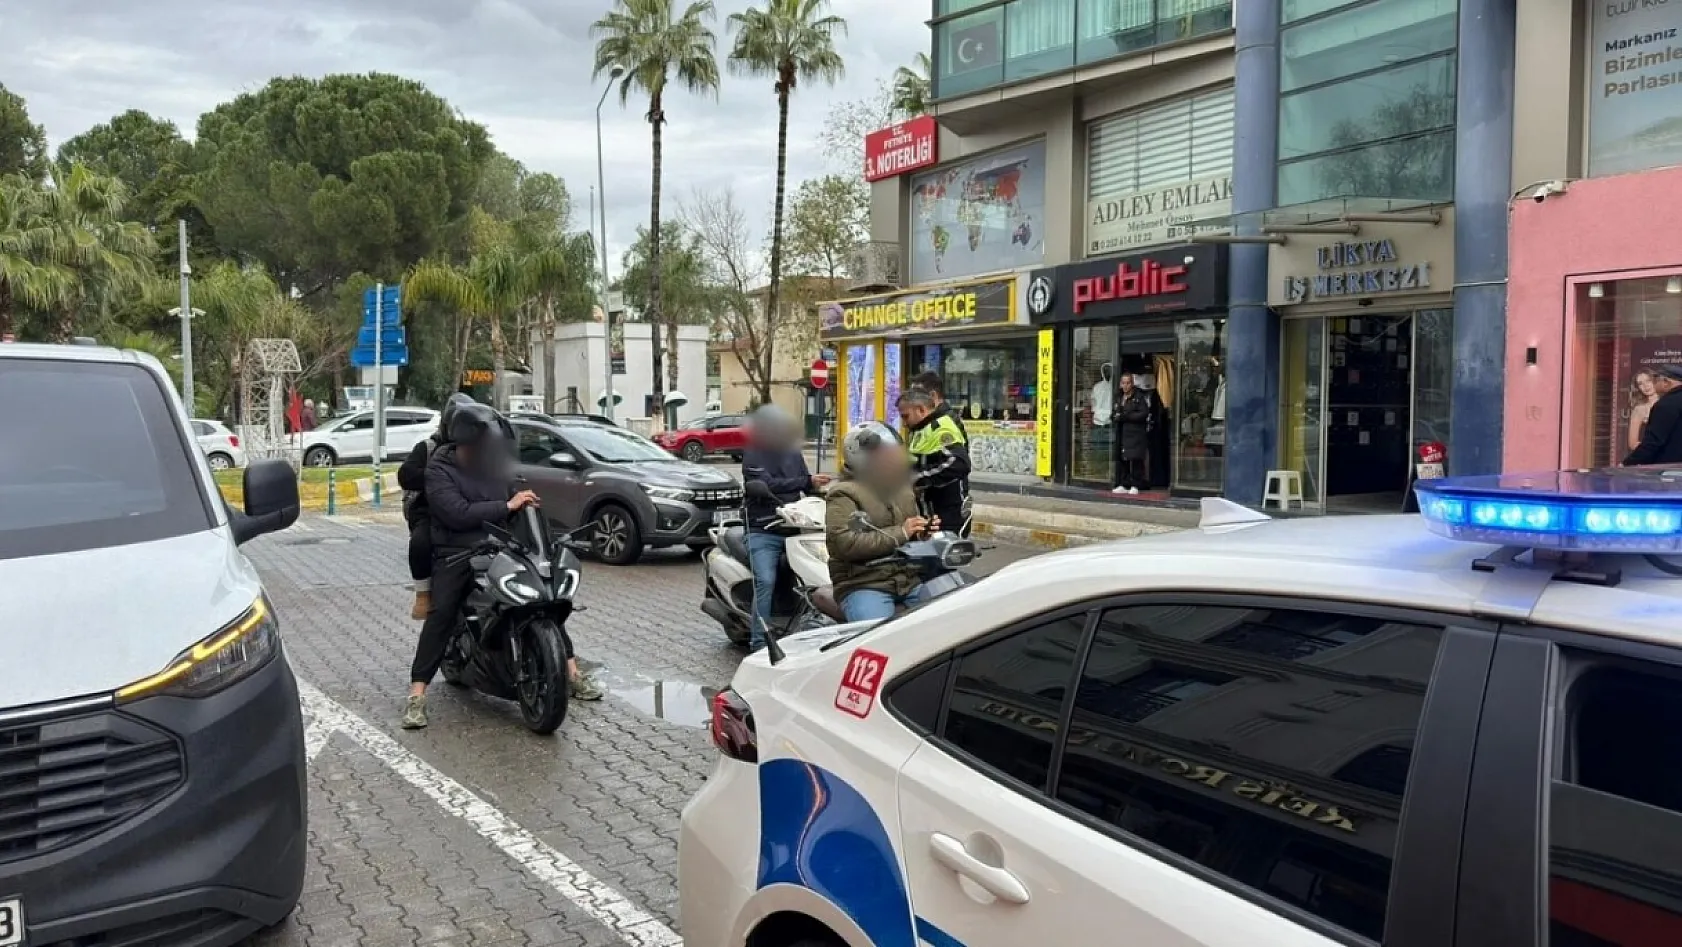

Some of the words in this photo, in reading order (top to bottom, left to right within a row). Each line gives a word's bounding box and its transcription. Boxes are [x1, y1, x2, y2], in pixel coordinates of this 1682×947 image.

[1605, 28, 1677, 53] Markanız
[1605, 46, 1682, 75] Bizimle
[877, 133, 932, 175] NOTERLİĞİ
[1093, 192, 1156, 225] ADLEY
[1317, 239, 1397, 269] LİKYA
[1072, 258, 1189, 314] public
[844, 302, 907, 330] CHANGE
[911, 293, 976, 322] OFFICE
[1039, 347, 1050, 460] WECHSEL
[848, 656, 878, 690] 112
